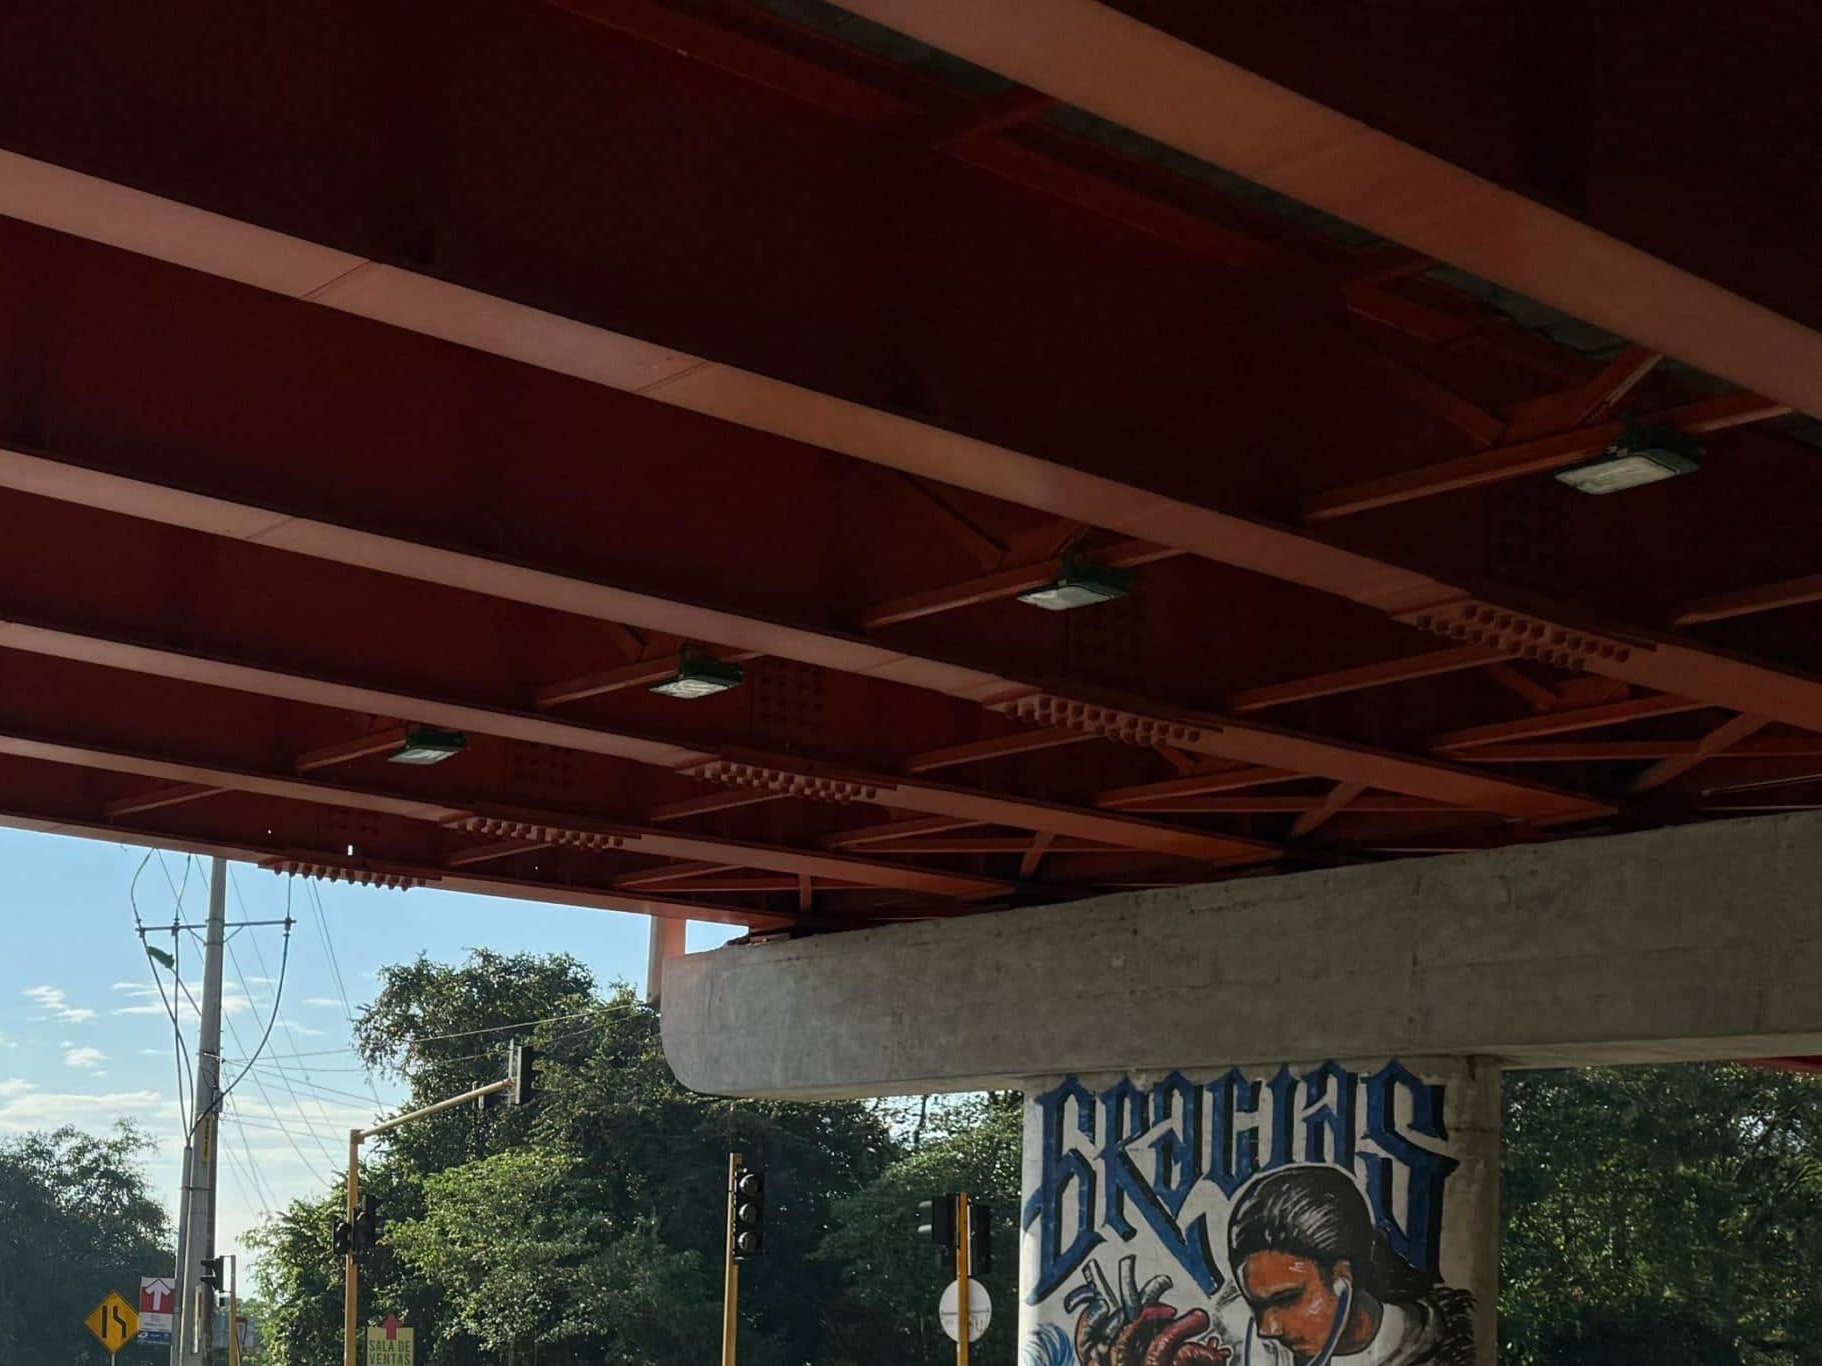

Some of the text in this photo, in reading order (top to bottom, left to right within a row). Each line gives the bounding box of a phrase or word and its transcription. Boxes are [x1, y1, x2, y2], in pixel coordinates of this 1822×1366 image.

[369, 1340, 411, 1353] SALA DE
[369, 1353, 411, 1366] VENTAS
